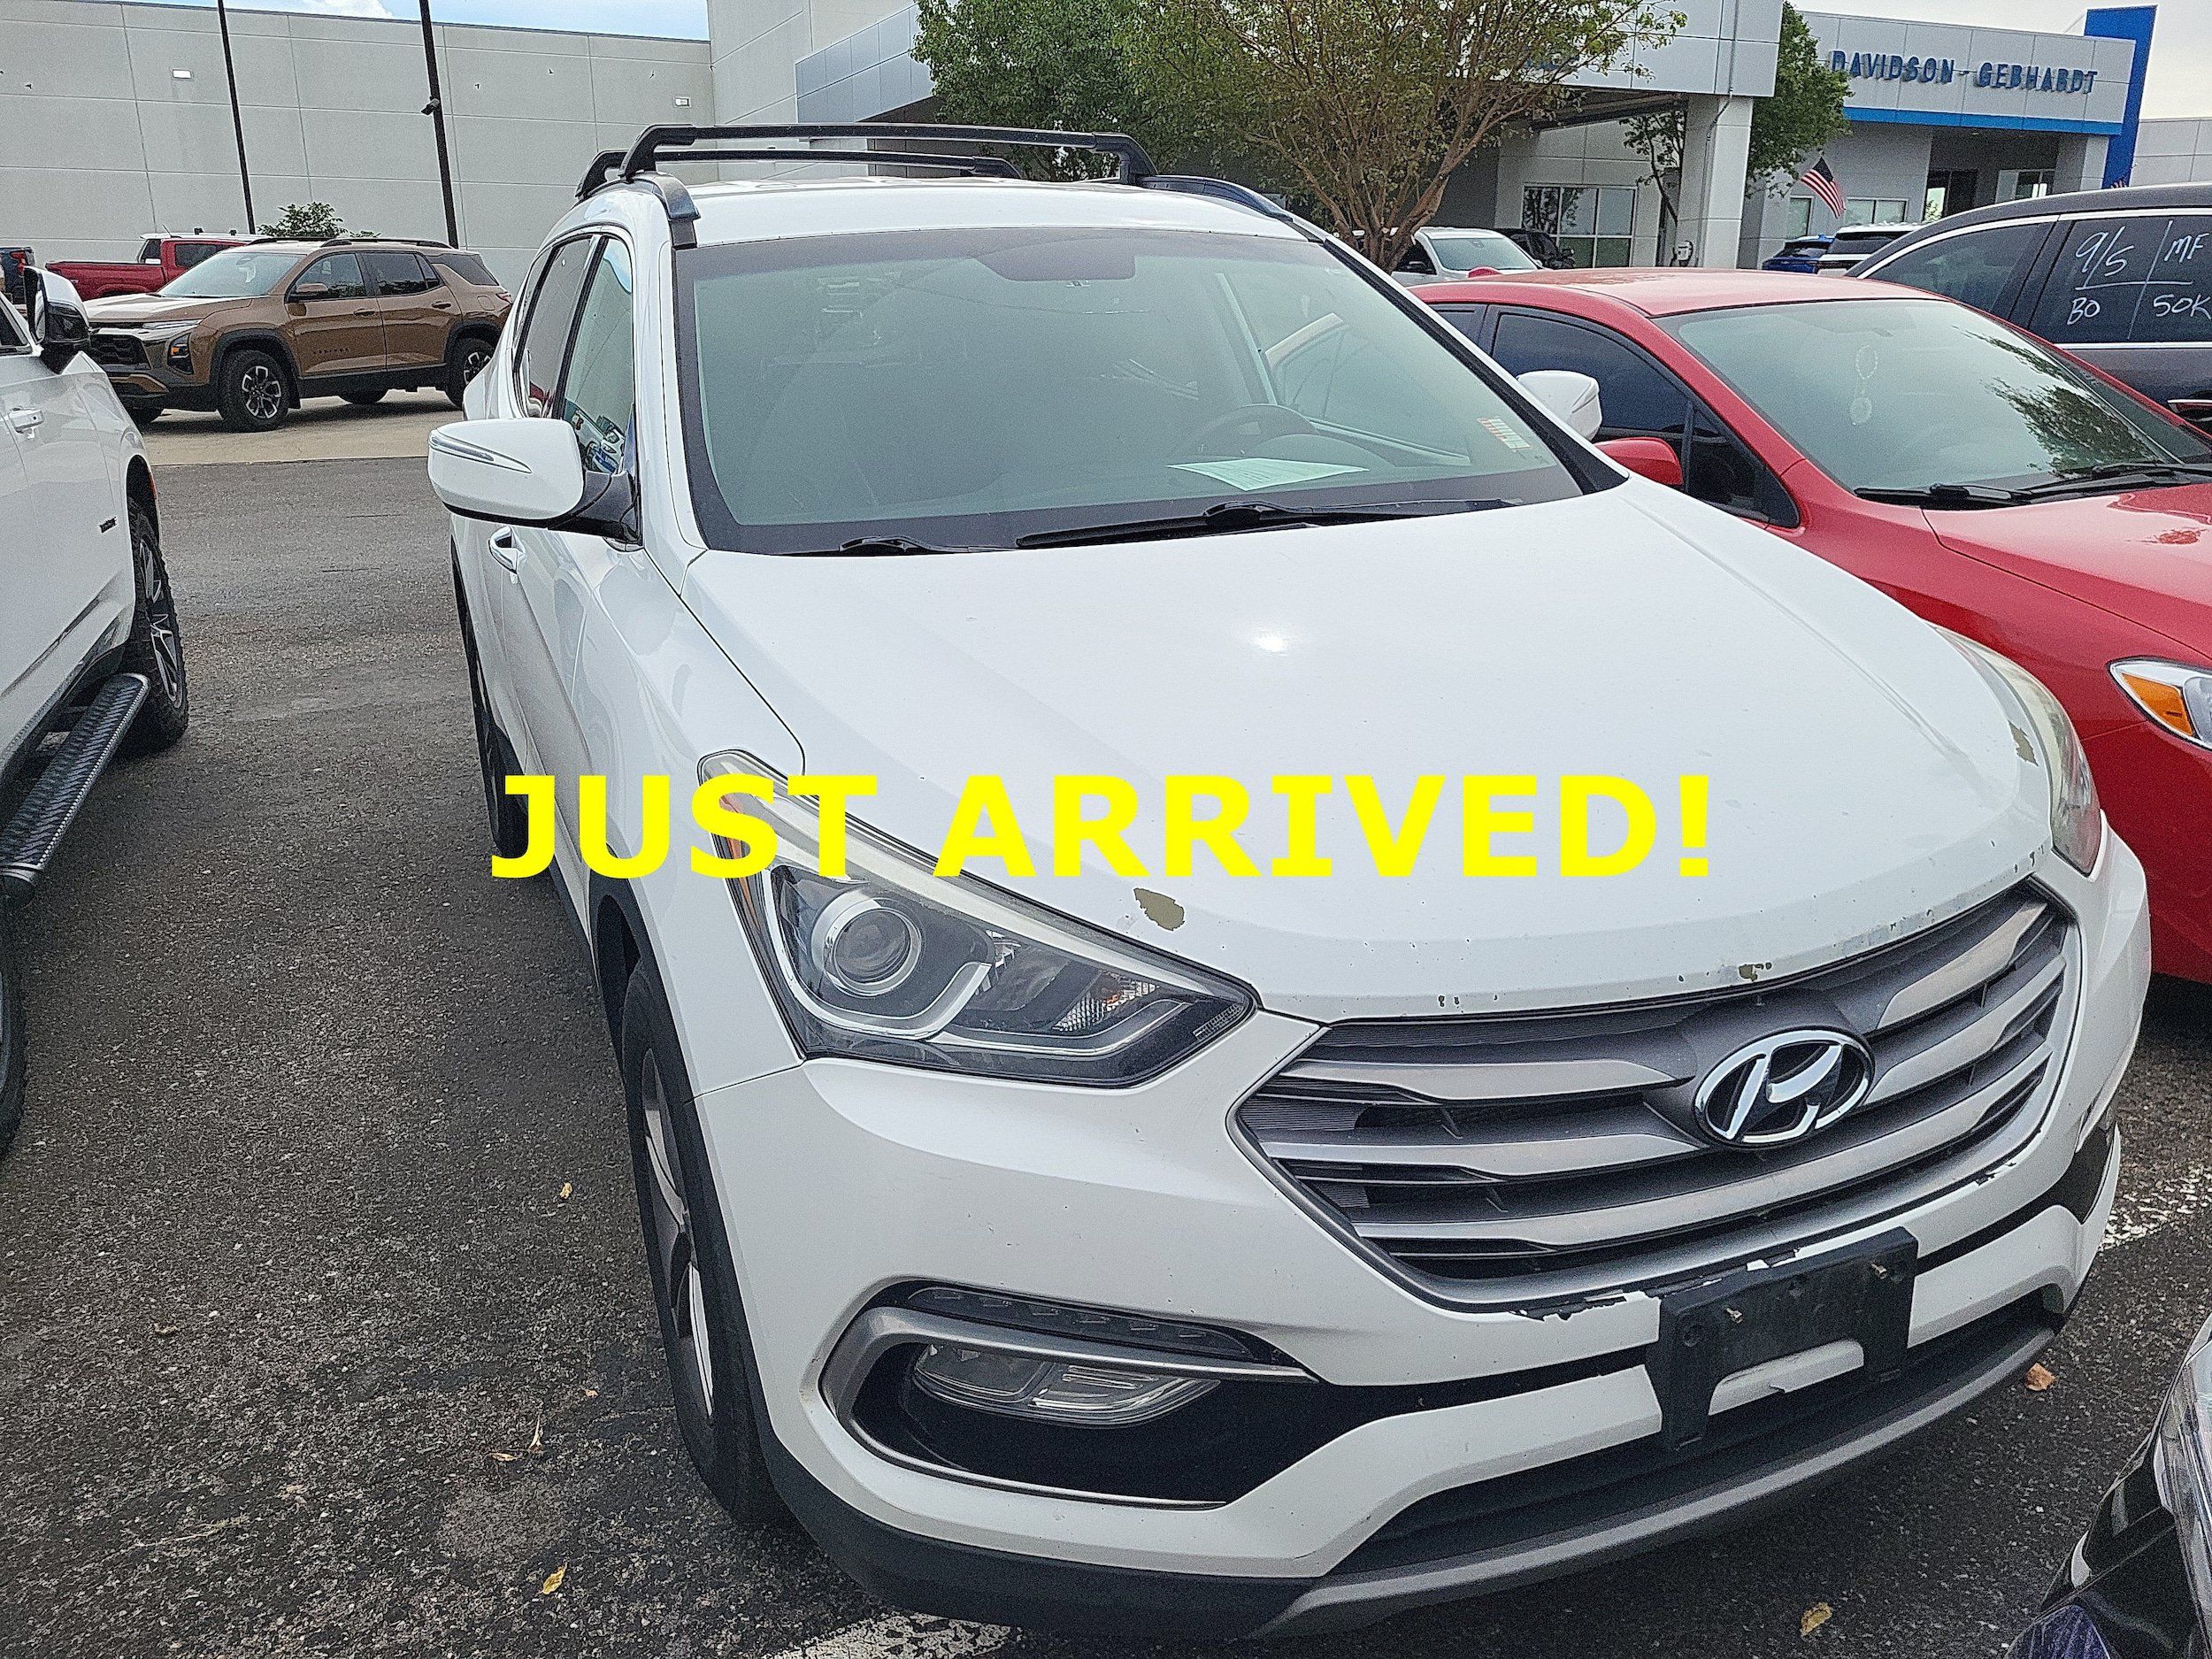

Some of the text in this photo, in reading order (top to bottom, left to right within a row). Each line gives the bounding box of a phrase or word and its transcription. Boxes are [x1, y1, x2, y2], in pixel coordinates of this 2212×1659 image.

[1830, 50, 1955, 85] DAVIDSON
[1974, 61, 2098, 95] GEBHARDT
[2075, 226, 2135, 288] 9/5
[2163, 232, 2210, 264] MF
